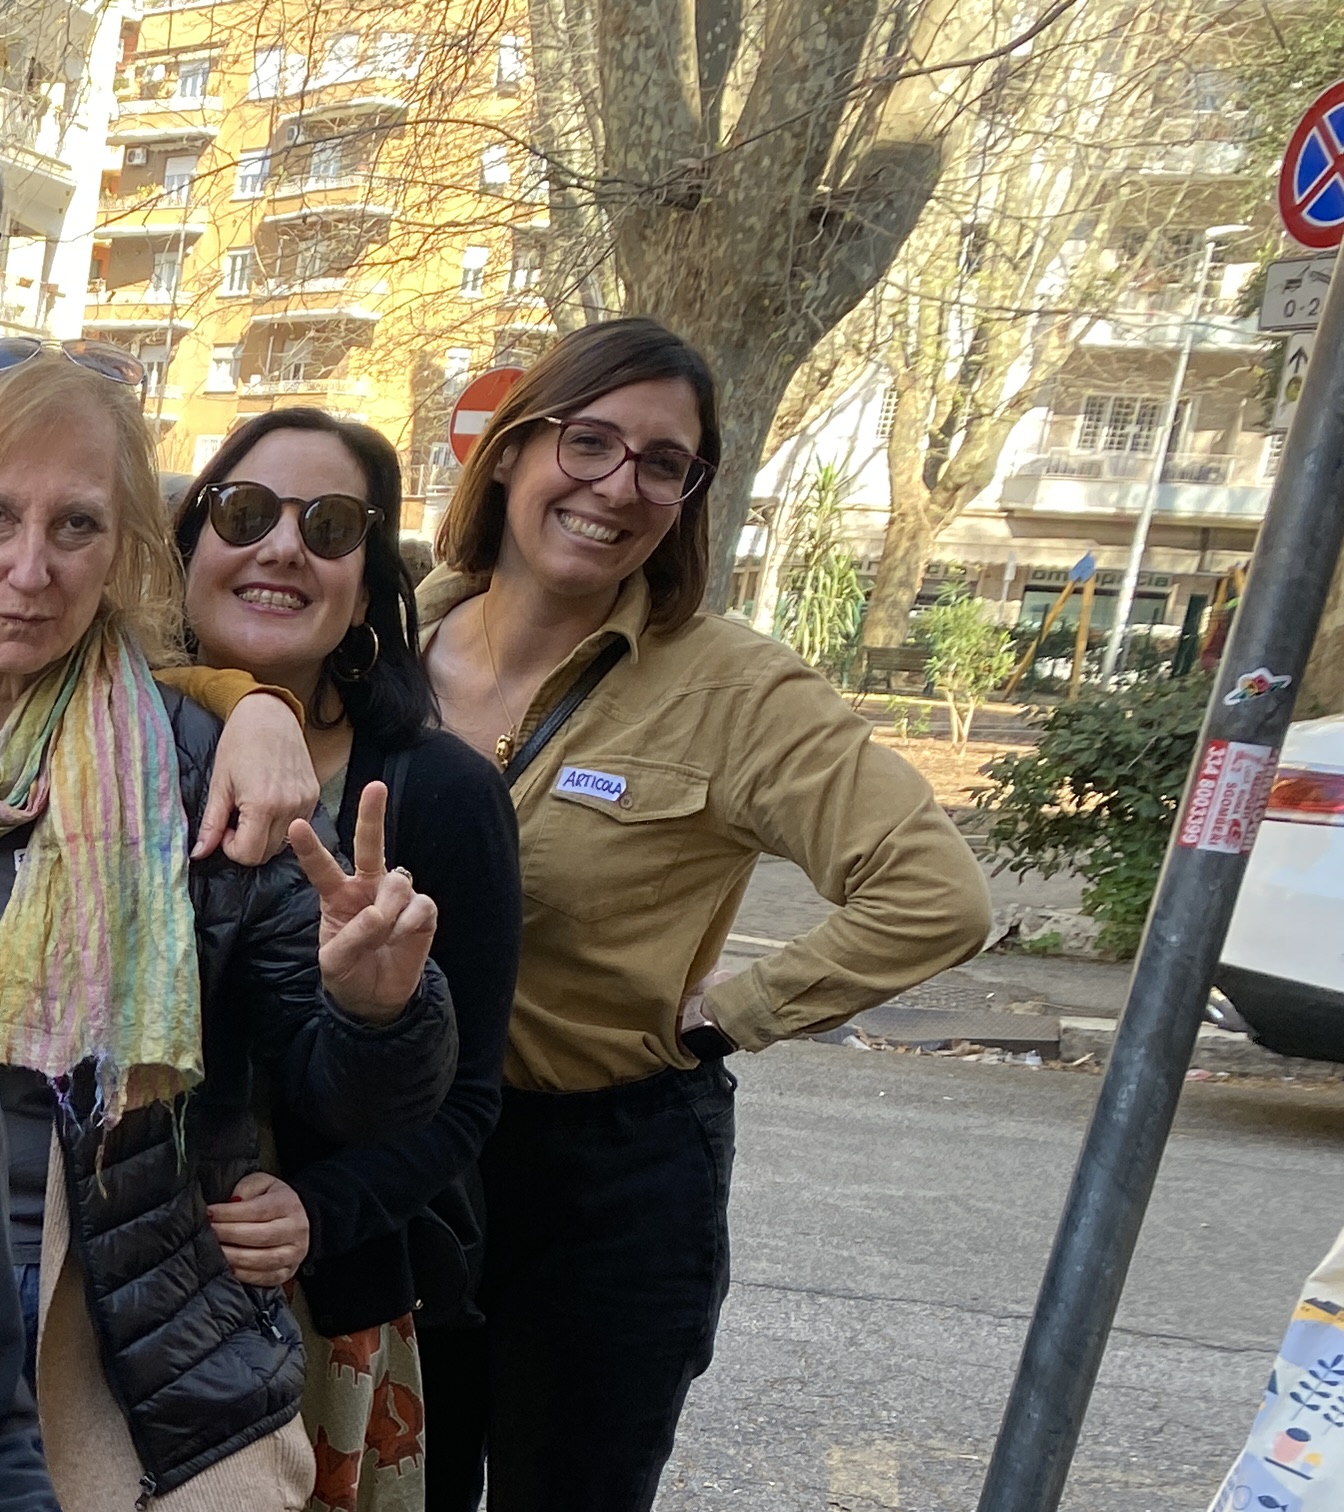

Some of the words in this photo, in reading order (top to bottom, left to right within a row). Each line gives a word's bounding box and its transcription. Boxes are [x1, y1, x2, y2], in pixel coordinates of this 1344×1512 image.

[1283, 297, 1321, 318] 0-2
[1200, 746, 1226, 776] 334
[562, 770, 622, 796] ARTICOLA
[1180, 777, 1216, 843] 8003399
